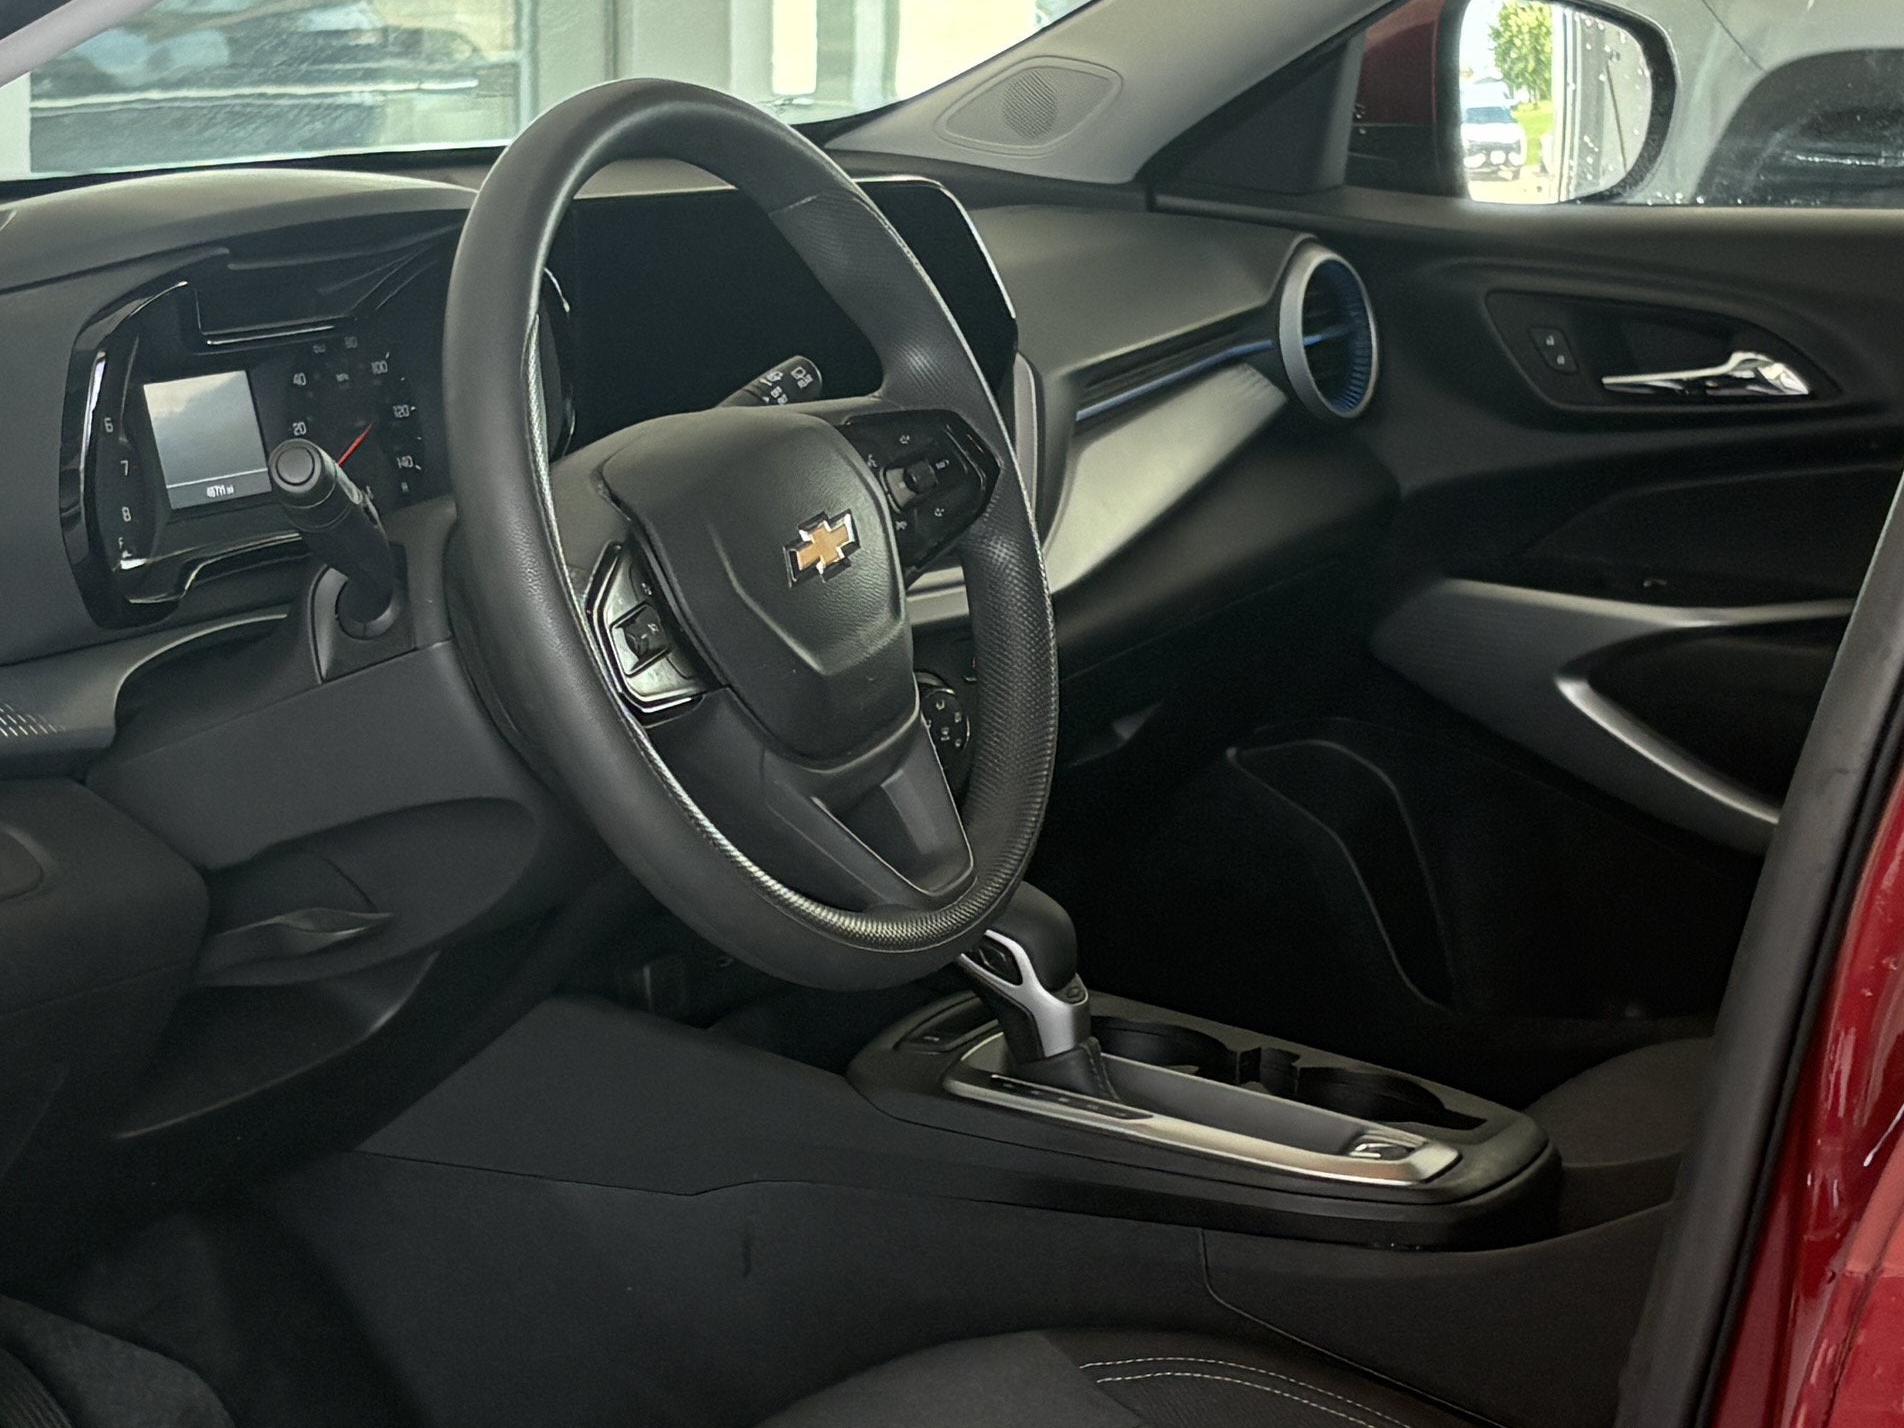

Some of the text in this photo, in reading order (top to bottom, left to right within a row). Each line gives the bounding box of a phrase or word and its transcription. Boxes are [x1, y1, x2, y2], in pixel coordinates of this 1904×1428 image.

[371, 360, 388, 374] 100
[293, 372, 307, 386] 40
[393, 404, 410, 418] 120
[104, 417, 114, 433] 6
[293, 422, 307, 436] 20
[120, 460, 129, 476] 7
[397, 455, 414, 469] 140
[121, 506, 132, 522] 8
